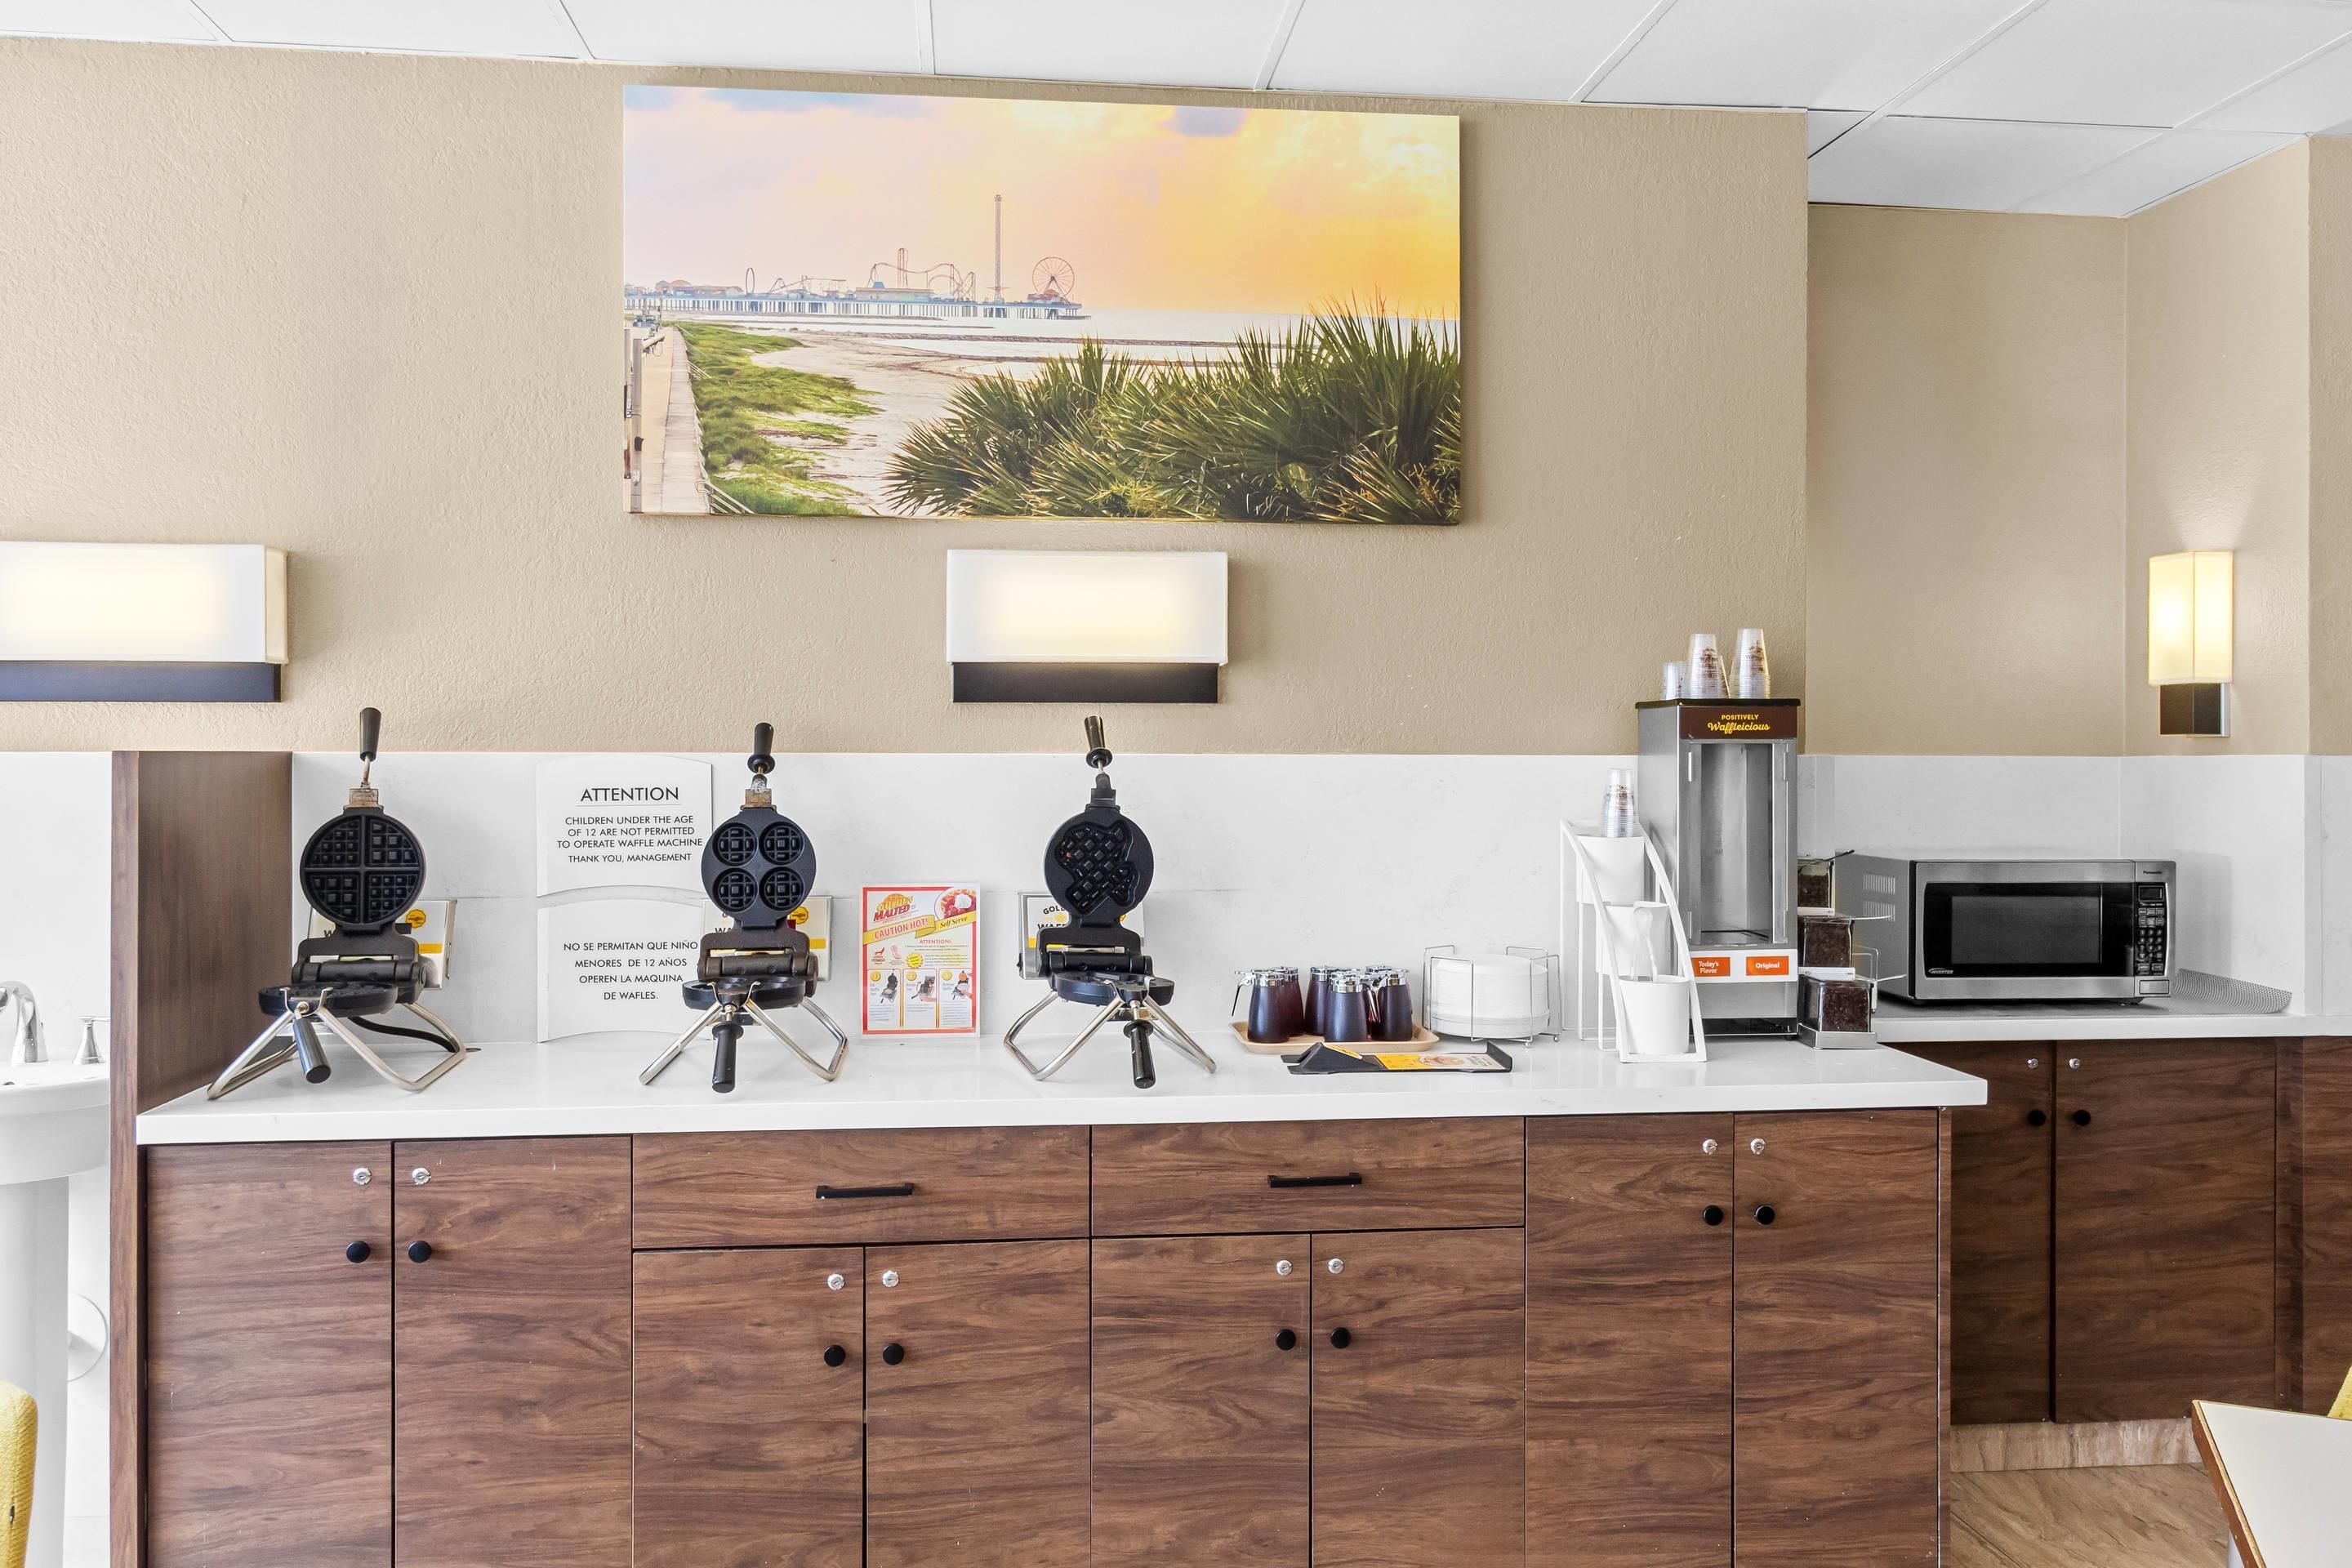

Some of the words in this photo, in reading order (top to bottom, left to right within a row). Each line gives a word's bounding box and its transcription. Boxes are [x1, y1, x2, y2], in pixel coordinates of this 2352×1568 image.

[1707, 721, 1771, 734] Waffleicious
[580, 786, 679, 802] ATTENTION
[565, 817, 613, 826] CHILDREN
[617, 817, 651, 825] UNDER
[653, 816, 671, 824] THE
[674, 816, 693, 824] AGE
[568, 828, 581, 837] OF
[586, 828, 596, 836] 12
[599, 828, 617, 836] ARE
[621, 827, 642, 836] NOT
[644, 826, 694, 835] PERMITTED
[557, 840, 570, 849] TO
[573, 840, 615, 849] OPERATE
[617, 839, 654, 848] WAFFLE
[657, 838, 703, 847] MACHINE
[568, 855, 599, 863] THANK
[602, 854, 624, 863] YOU,
[626, 853, 692, 862] MANAGEMENT
[874, 904, 911, 921] MALTED
[939, 919, 951, 928] Self
[951, 916, 968, 925] Serve
[875, 924, 908, 938] CAUTION
[910, 918, 929, 931] HOT!
[564, 942, 581, 951] NO
[583, 942, 595, 951] SE
[597, 942, 644, 951] PERMITAN
[646, 942, 668, 951] QUE
[671, 939, 698, 950] NIÑO
[575, 959, 622, 968] MENORES
[628, 959, 641, 967] DE
[644, 959, 656, 967] 12
[658, 956, 688, 967] AÑOS
[1699, 960, 1719, 969] Today's
[579, 975, 617, 984] OPEREN
[620, 974, 632, 983] LA
[635, 973, 684, 984] MAQUINA
[604, 991, 617, 1000] DE
[619, 991, 658, 1000] WAFLES.
